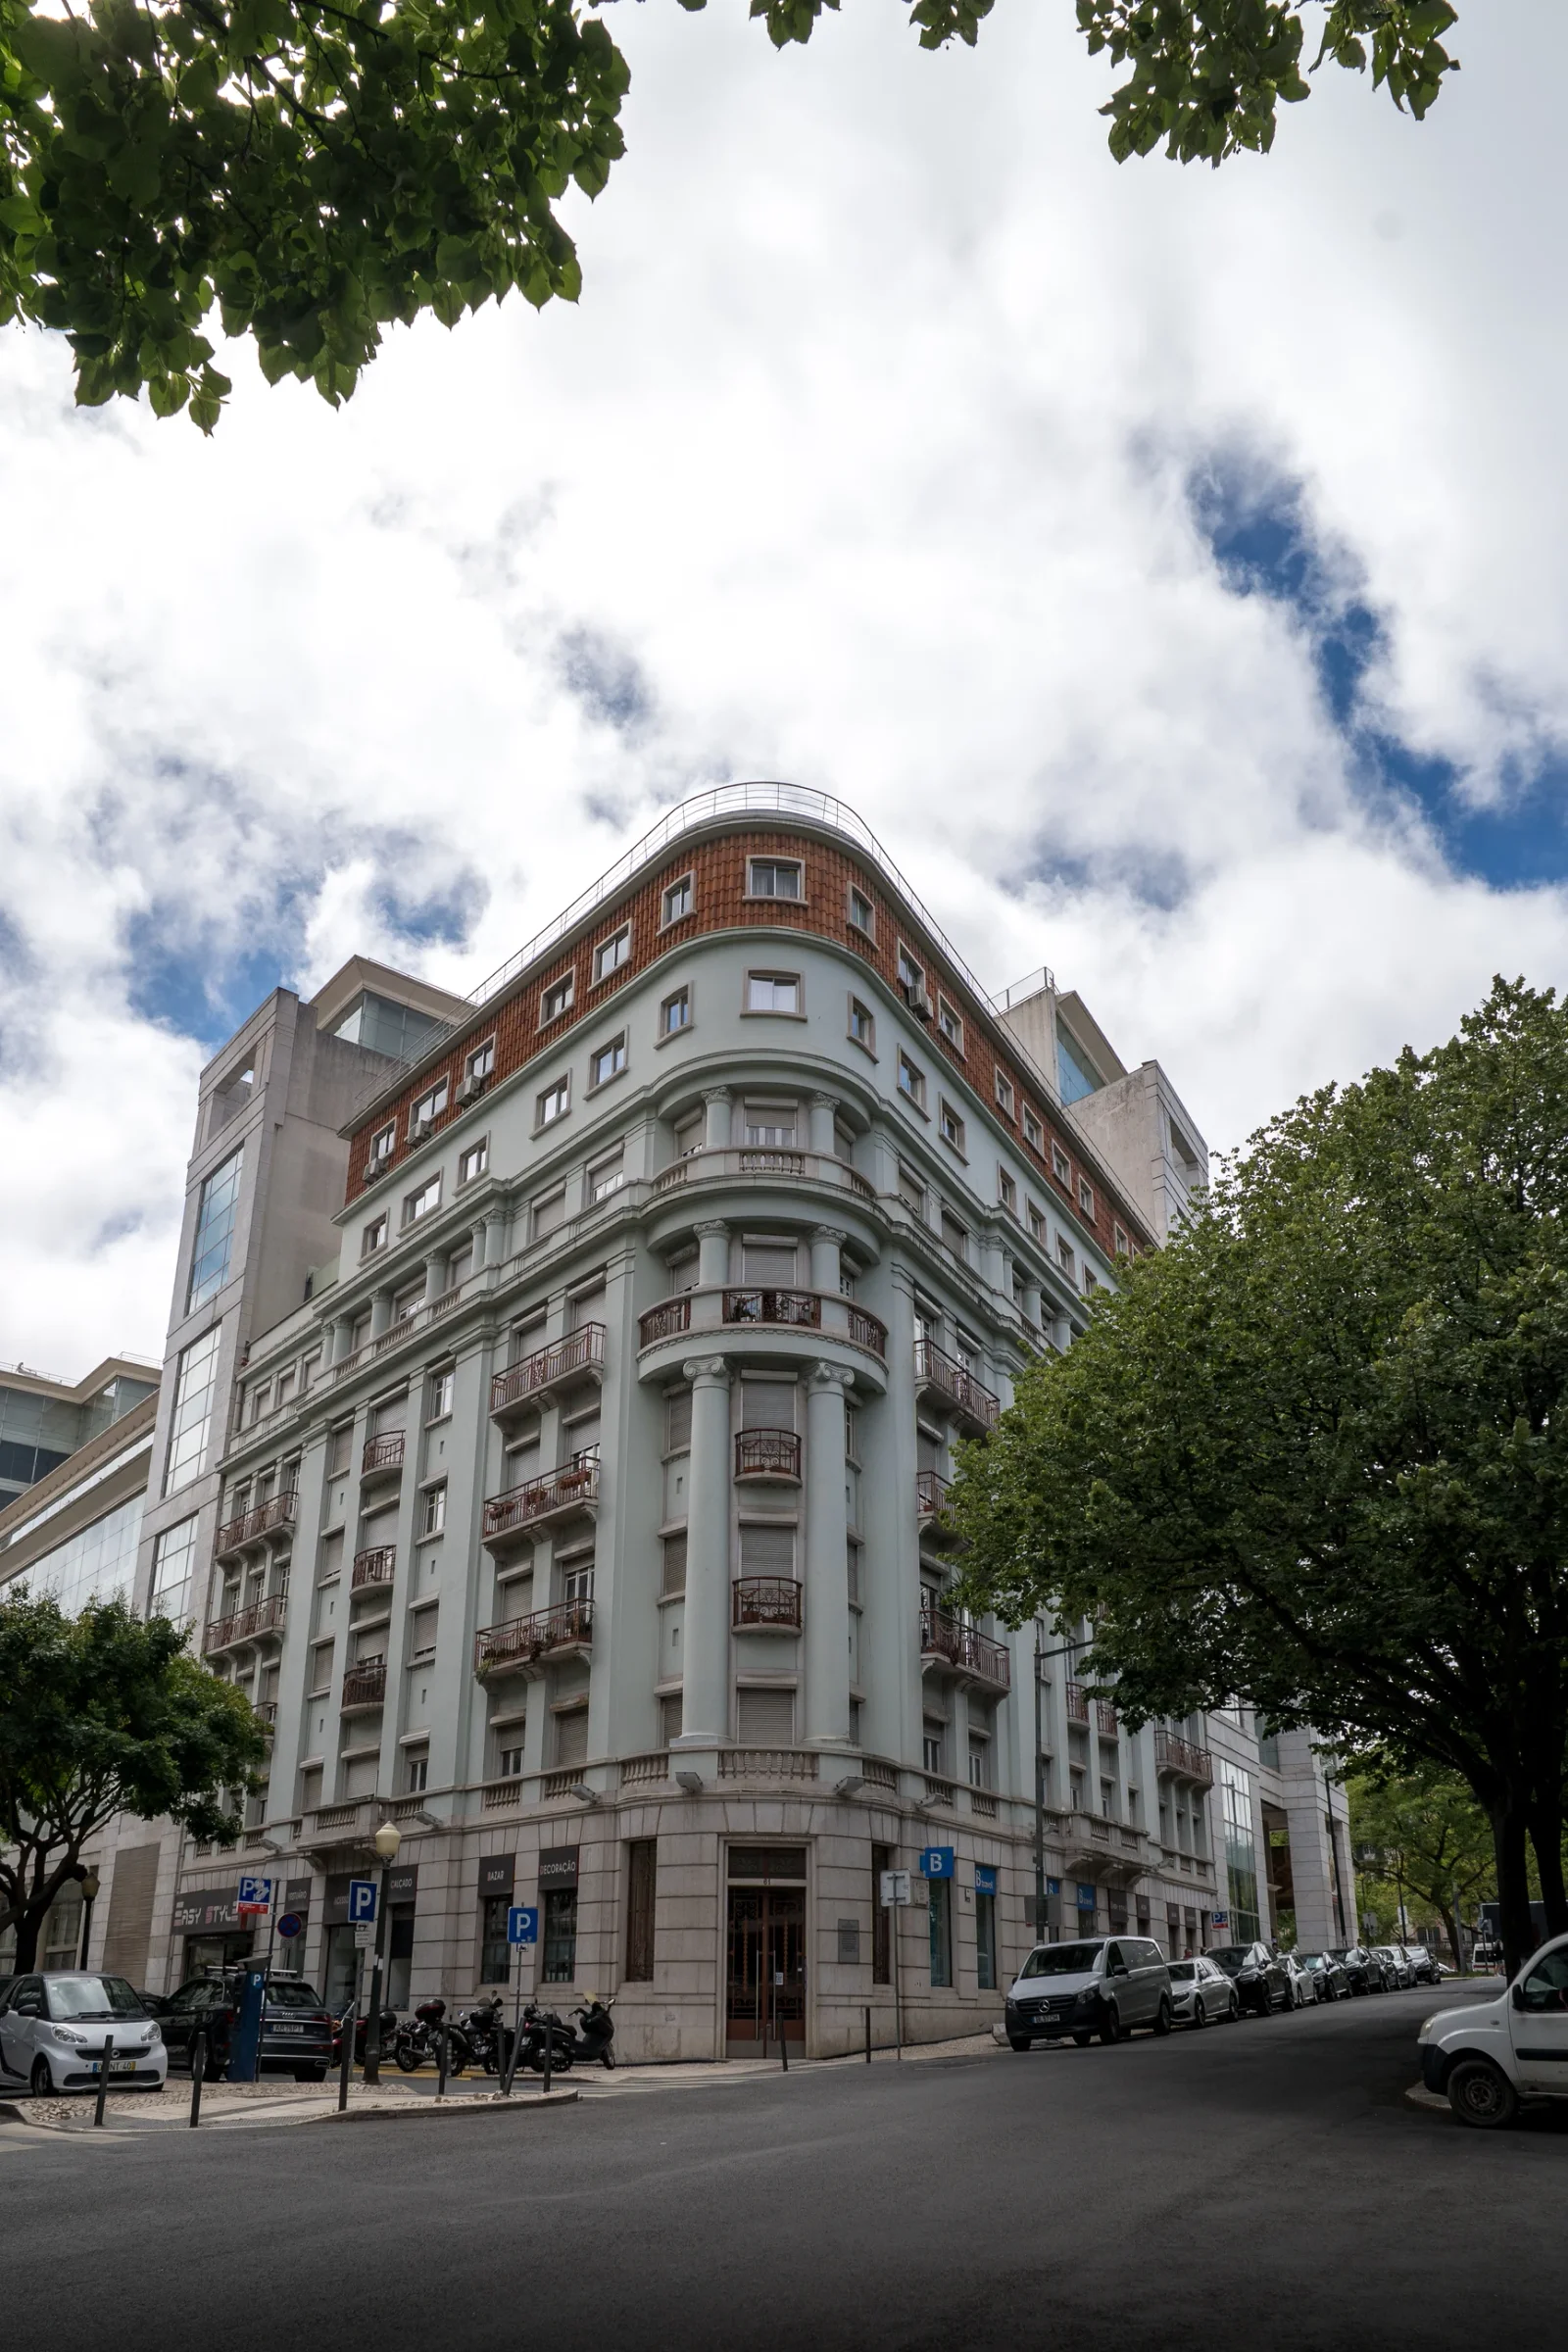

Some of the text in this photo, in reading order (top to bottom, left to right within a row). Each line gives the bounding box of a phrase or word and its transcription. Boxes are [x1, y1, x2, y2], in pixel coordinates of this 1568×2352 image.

[540, 1860, 576, 1875] DECORAÇÃO
[390, 1878, 413, 1889] CALÇADO
[487, 1870, 505, 1882] BAZAR
[242, 1880, 254, 1896] P
[356, 1886, 372, 1916] P
[515, 1913, 531, 1937] P
[253, 1974, 262, 1986] P
